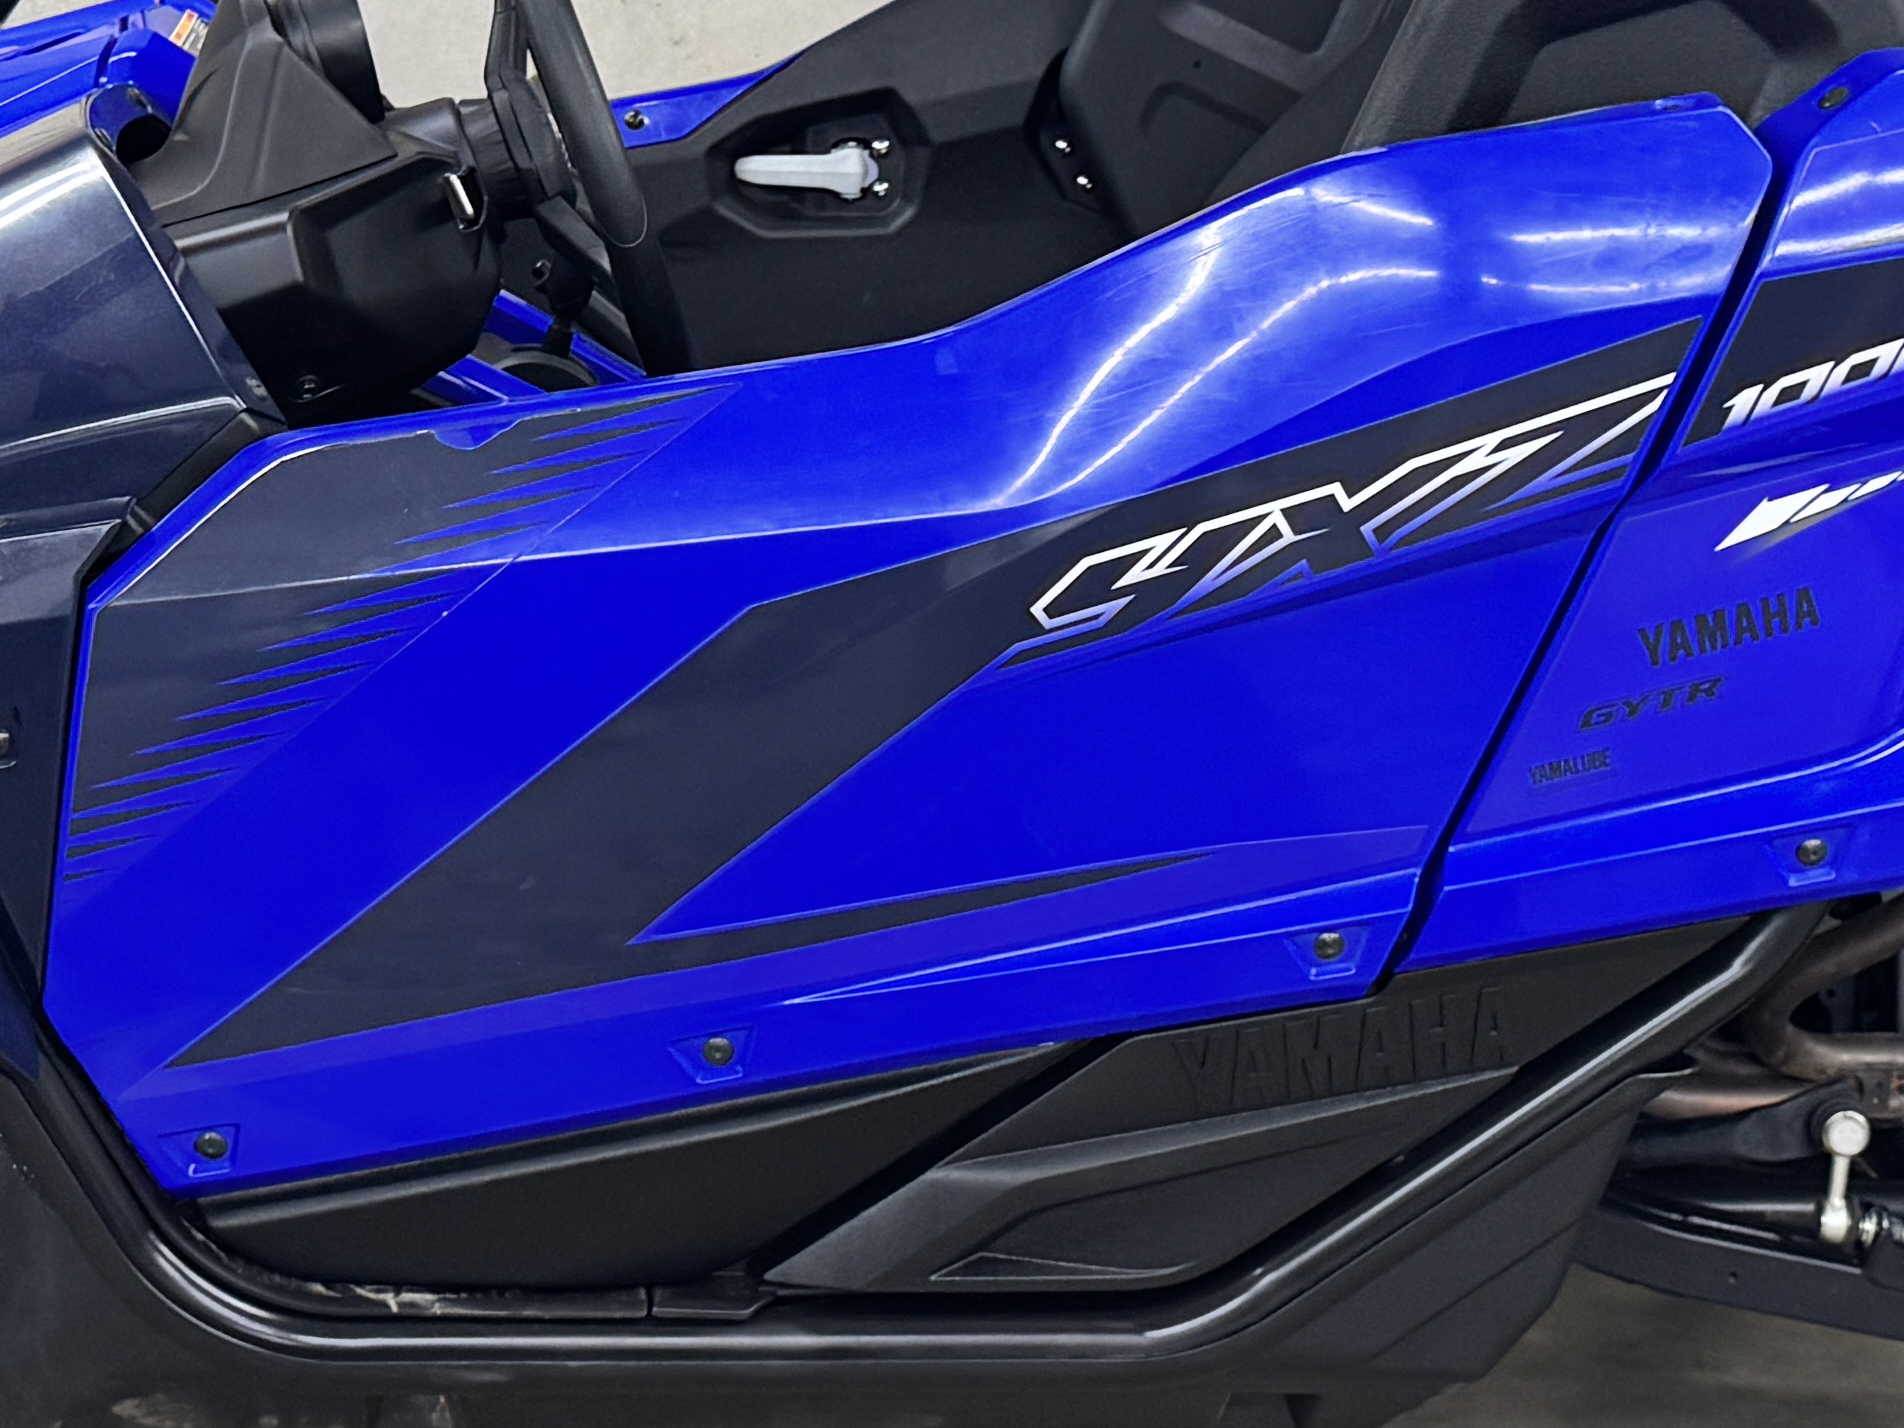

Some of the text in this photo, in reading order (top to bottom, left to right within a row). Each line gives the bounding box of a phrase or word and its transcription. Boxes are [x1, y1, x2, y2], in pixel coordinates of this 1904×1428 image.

[1637, 586, 1821, 667] YAMAHA
[1578, 676, 1724, 730] GYTR
[1528, 746, 1611, 785] YAMALUBE
[1172, 984, 1508, 1110] YAMAHA
